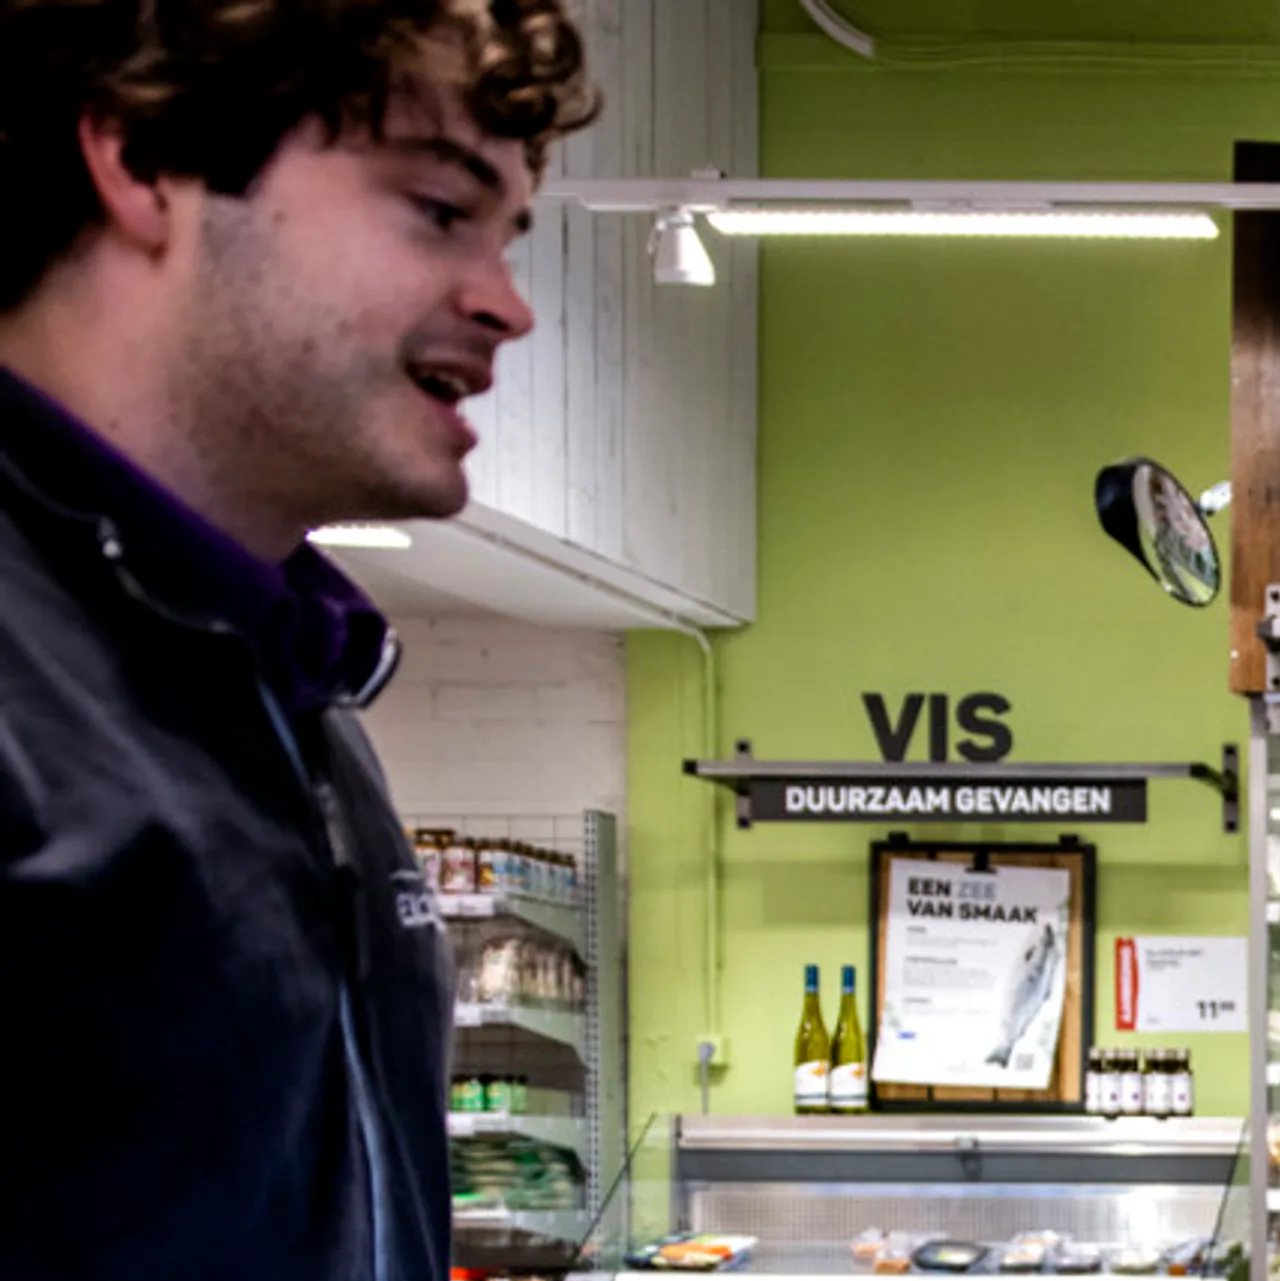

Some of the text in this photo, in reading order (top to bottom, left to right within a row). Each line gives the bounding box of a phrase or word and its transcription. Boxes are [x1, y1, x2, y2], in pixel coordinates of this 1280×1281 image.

[861, 692, 1013, 763] VIS
[786, 786, 1112, 813] DUURZAAM GEVANGEN
[907, 876, 997, 900] EEN ZEE
[906, 899, 1039, 924] VAN SMAAK
